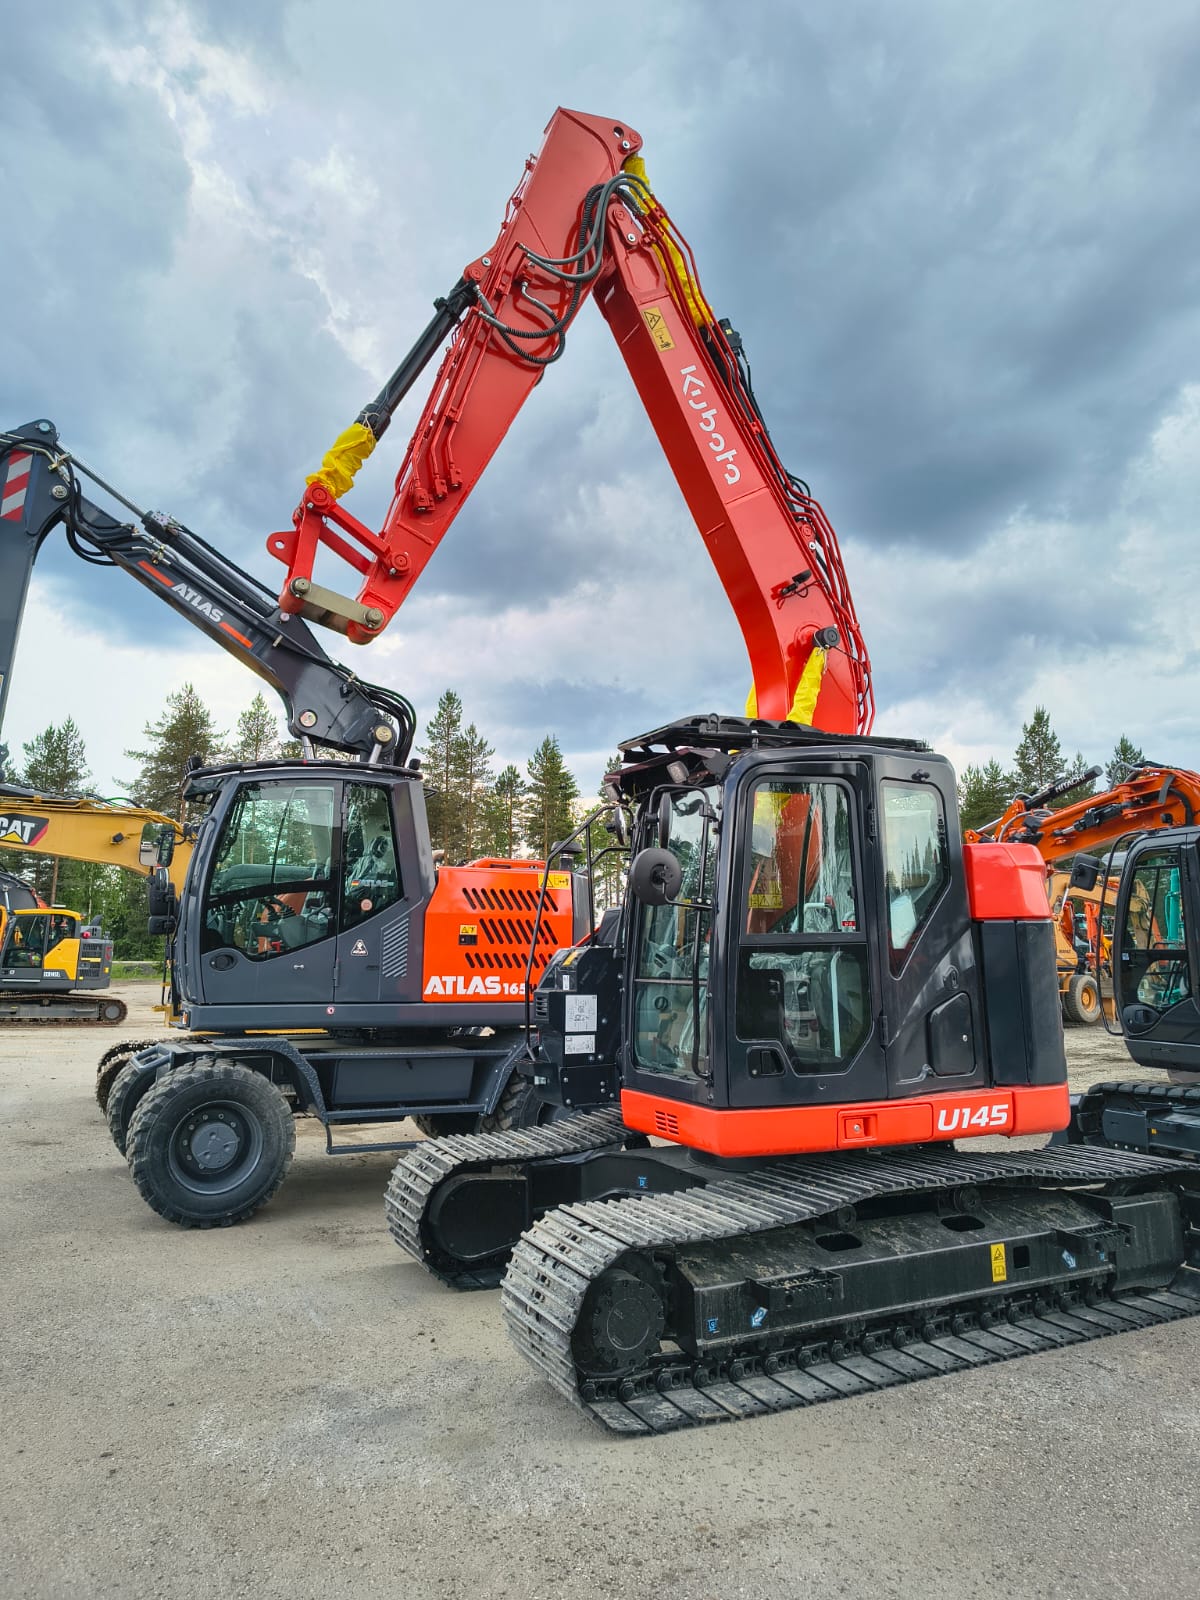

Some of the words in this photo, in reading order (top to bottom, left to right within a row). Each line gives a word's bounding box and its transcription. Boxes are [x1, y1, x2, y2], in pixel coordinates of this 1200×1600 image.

[681, 365, 741, 485] Kubota
[171, 583, 224, 622] ATLAS
[1055, 774, 1086, 793] HITACHI
[0, 817, 35, 844] CAT
[424, 976, 501, 995] ATLAS
[937, 1104, 1009, 1131] U145
